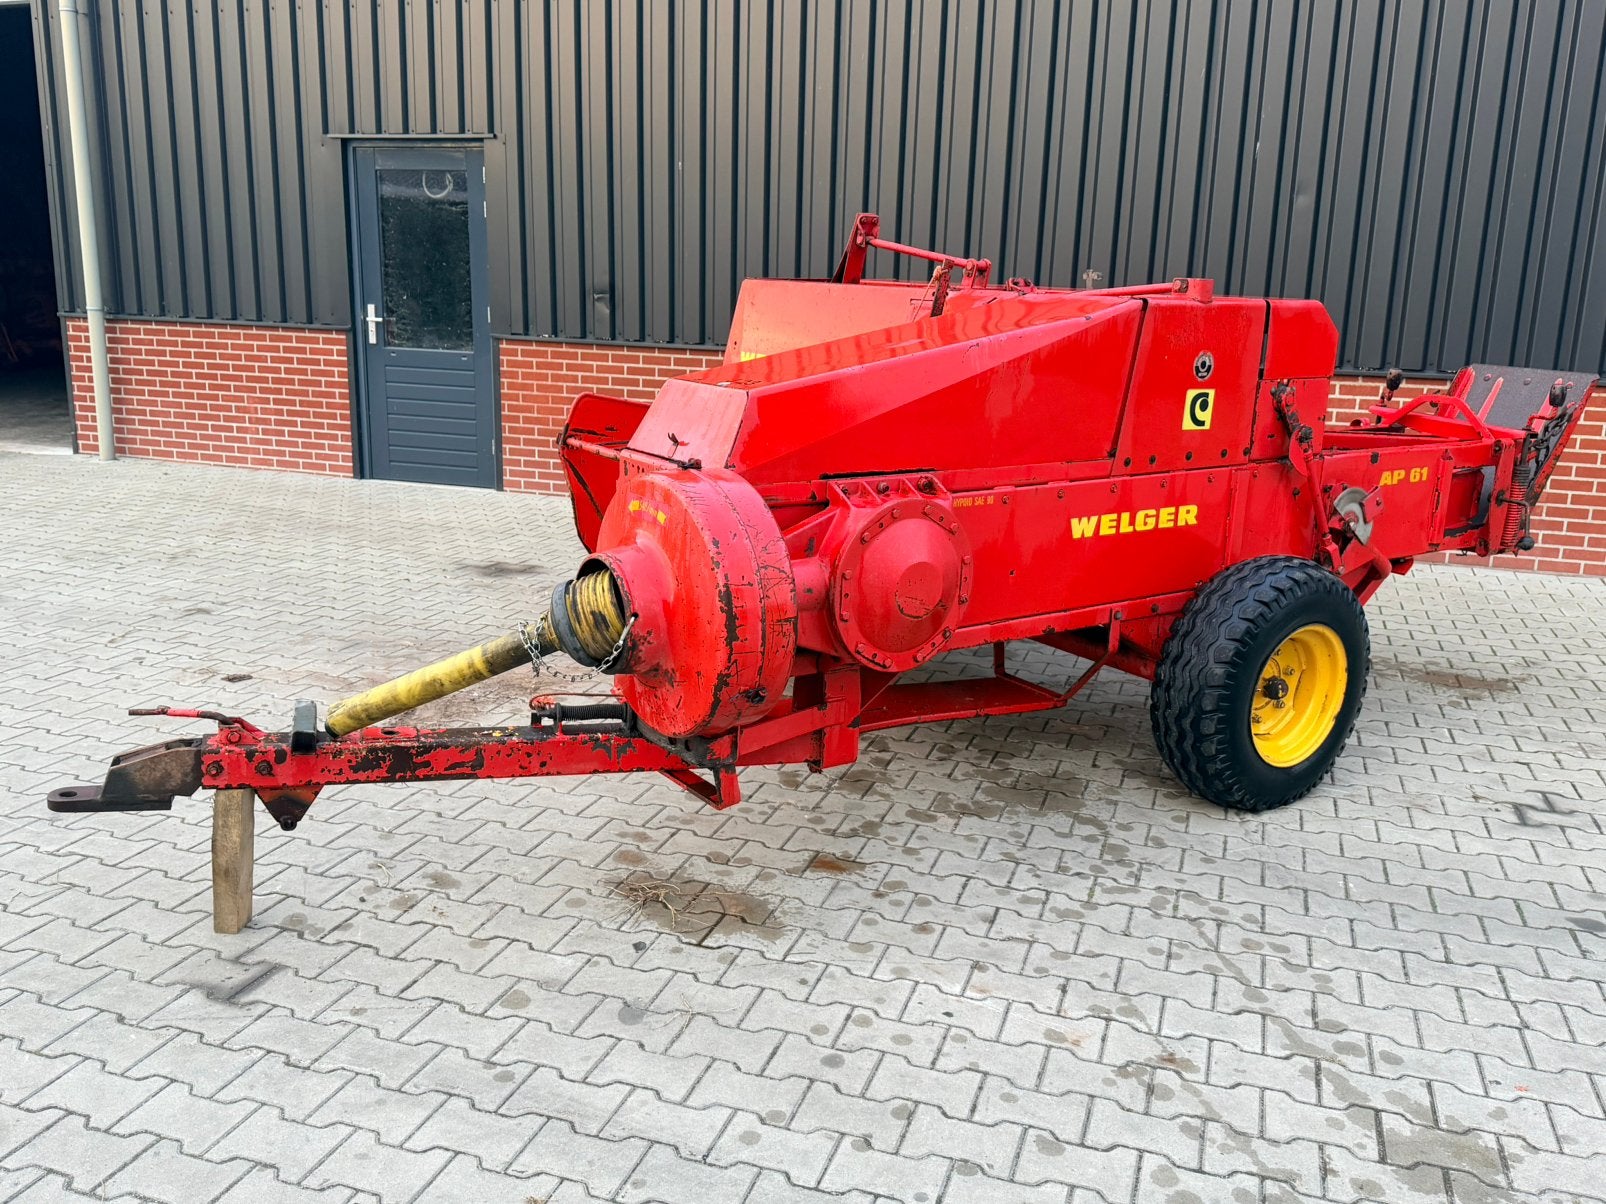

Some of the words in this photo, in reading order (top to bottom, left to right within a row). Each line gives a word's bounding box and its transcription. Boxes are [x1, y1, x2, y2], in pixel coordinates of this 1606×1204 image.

[1379, 469, 1406, 486] AP
[1409, 466, 1429, 483] 61
[974, 496, 985, 506] SAE
[1070, 504, 1199, 539] WELGER
